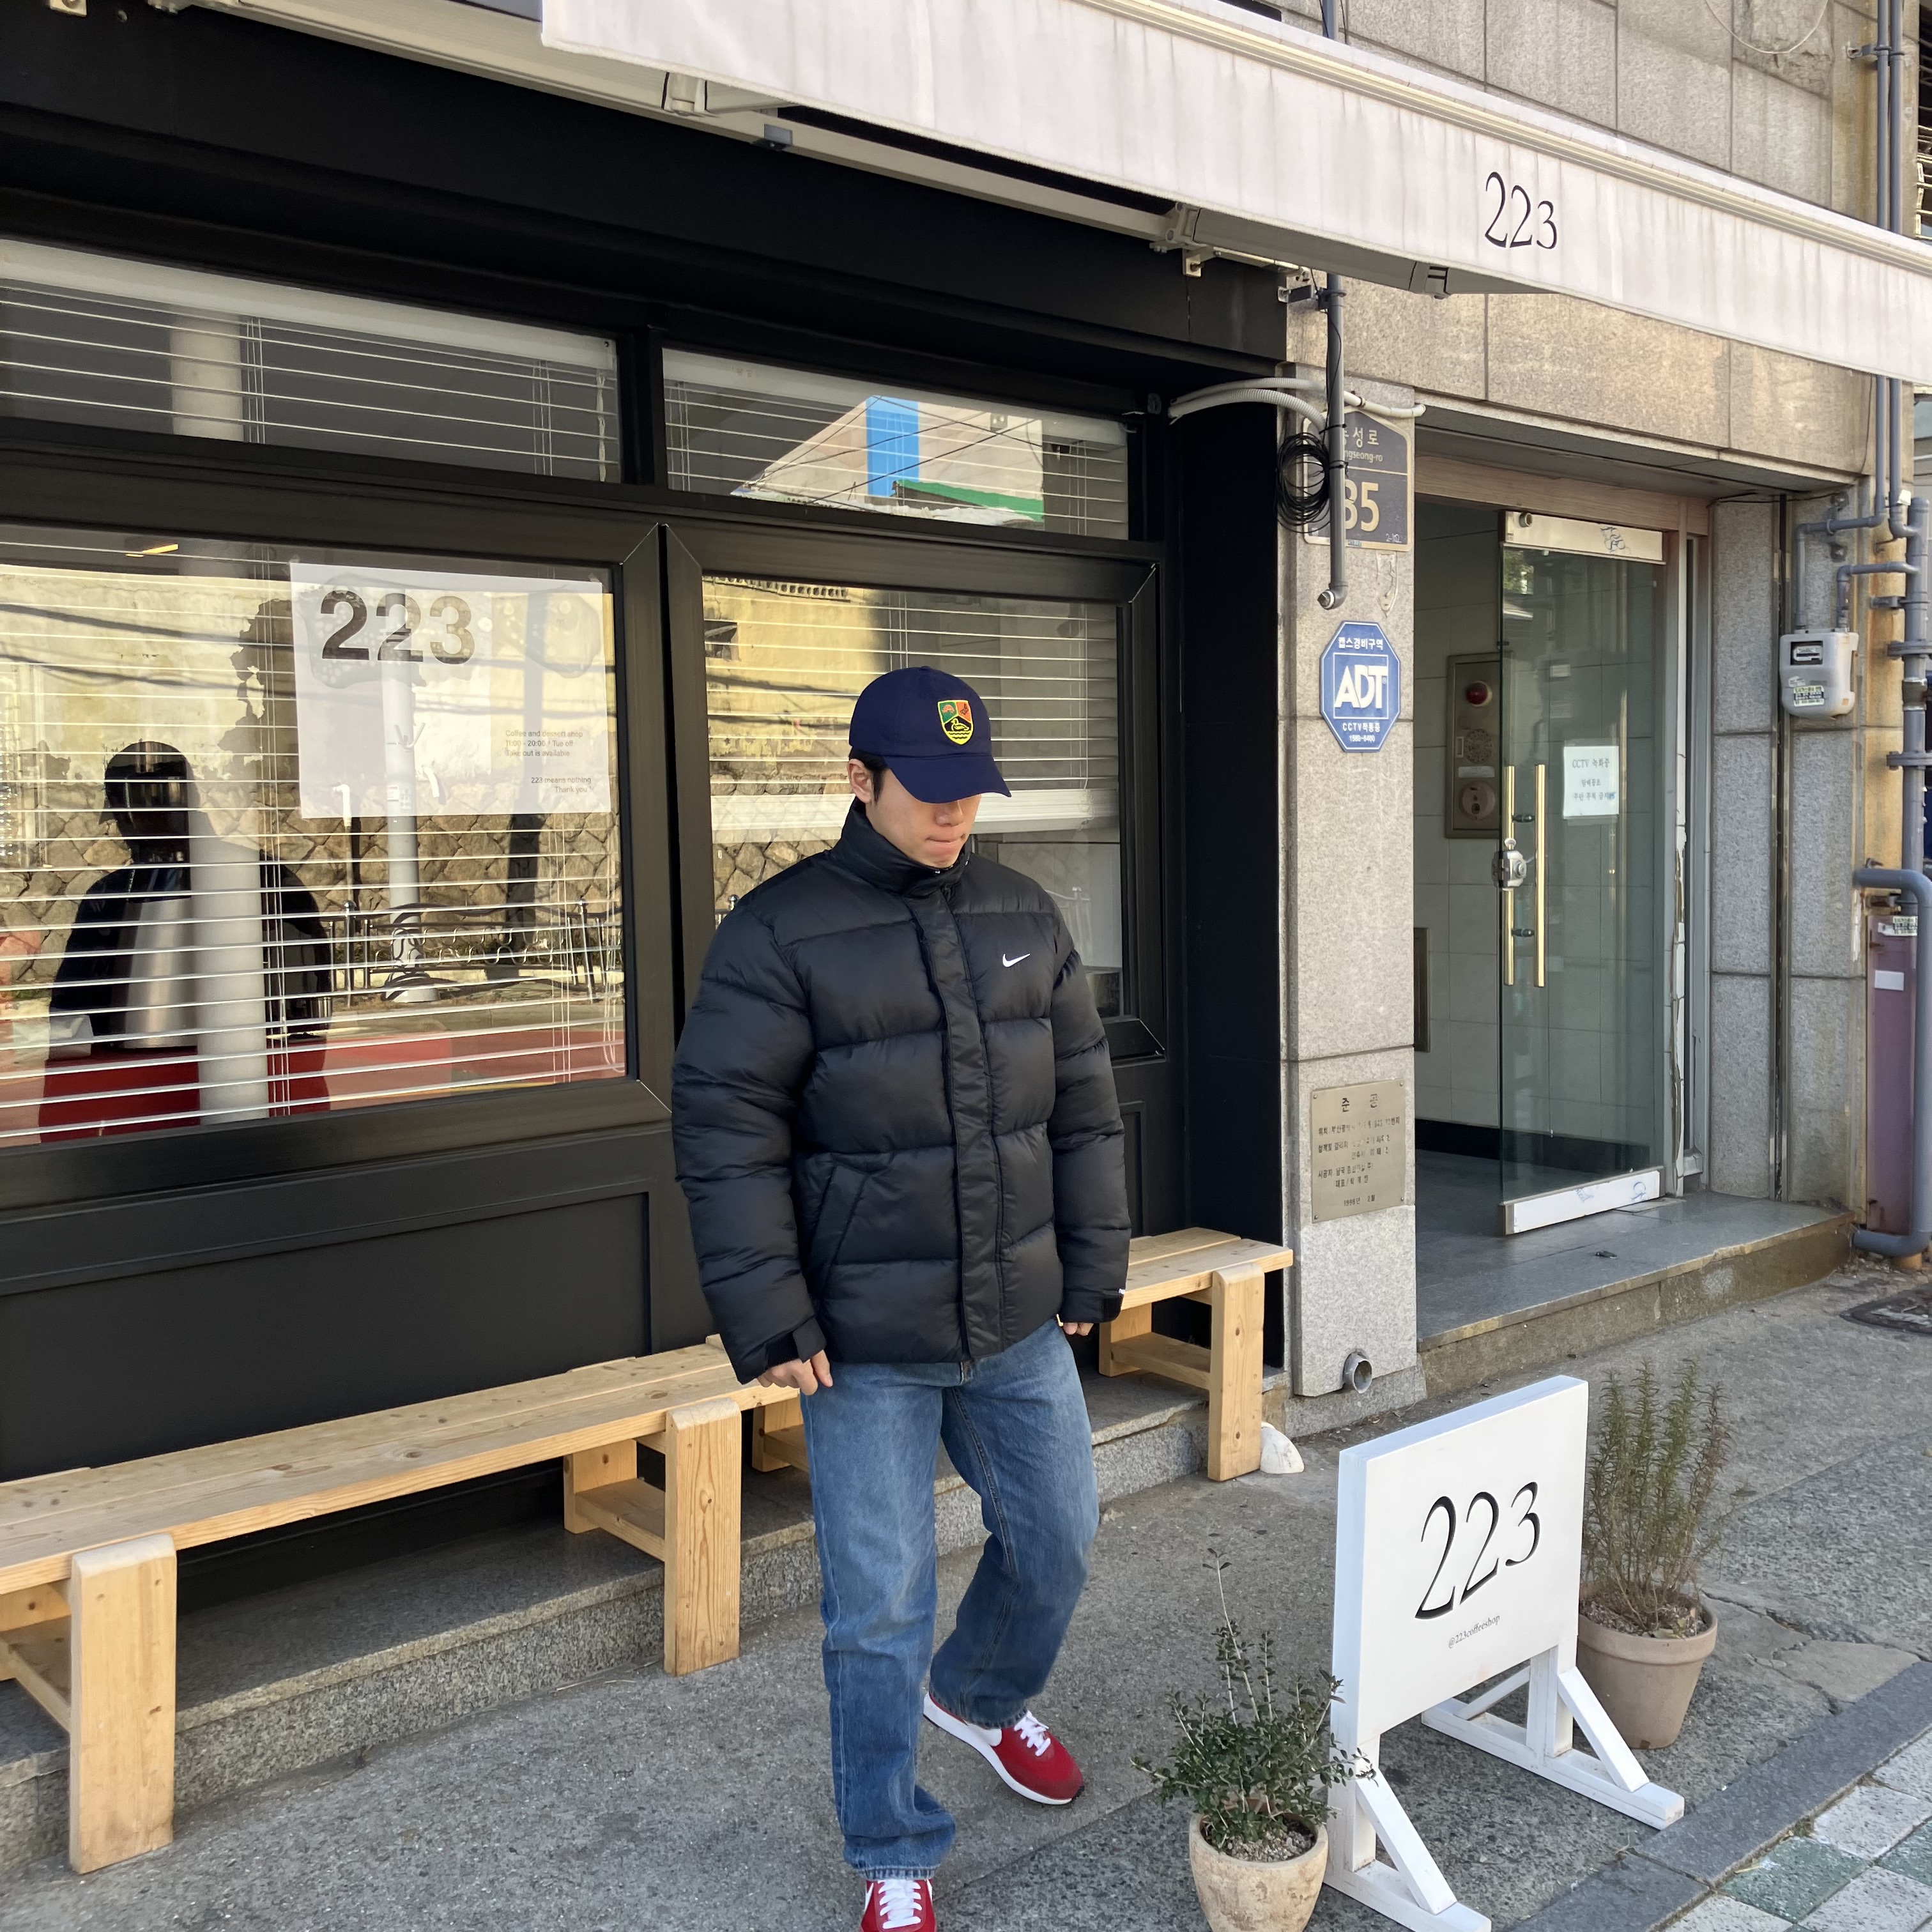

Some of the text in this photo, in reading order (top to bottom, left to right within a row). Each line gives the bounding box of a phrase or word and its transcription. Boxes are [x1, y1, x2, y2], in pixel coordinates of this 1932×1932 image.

[1485, 171, 1557, 249] 223
[320, 590, 475, 664] 223
[1334, 665, 1388, 709] ADT
[1572, 758, 1610, 769] CCTV 녹화중
[1414, 1481, 1540, 1620] 223
[1448, 1614, 1500, 1649] @223coffeeshop
